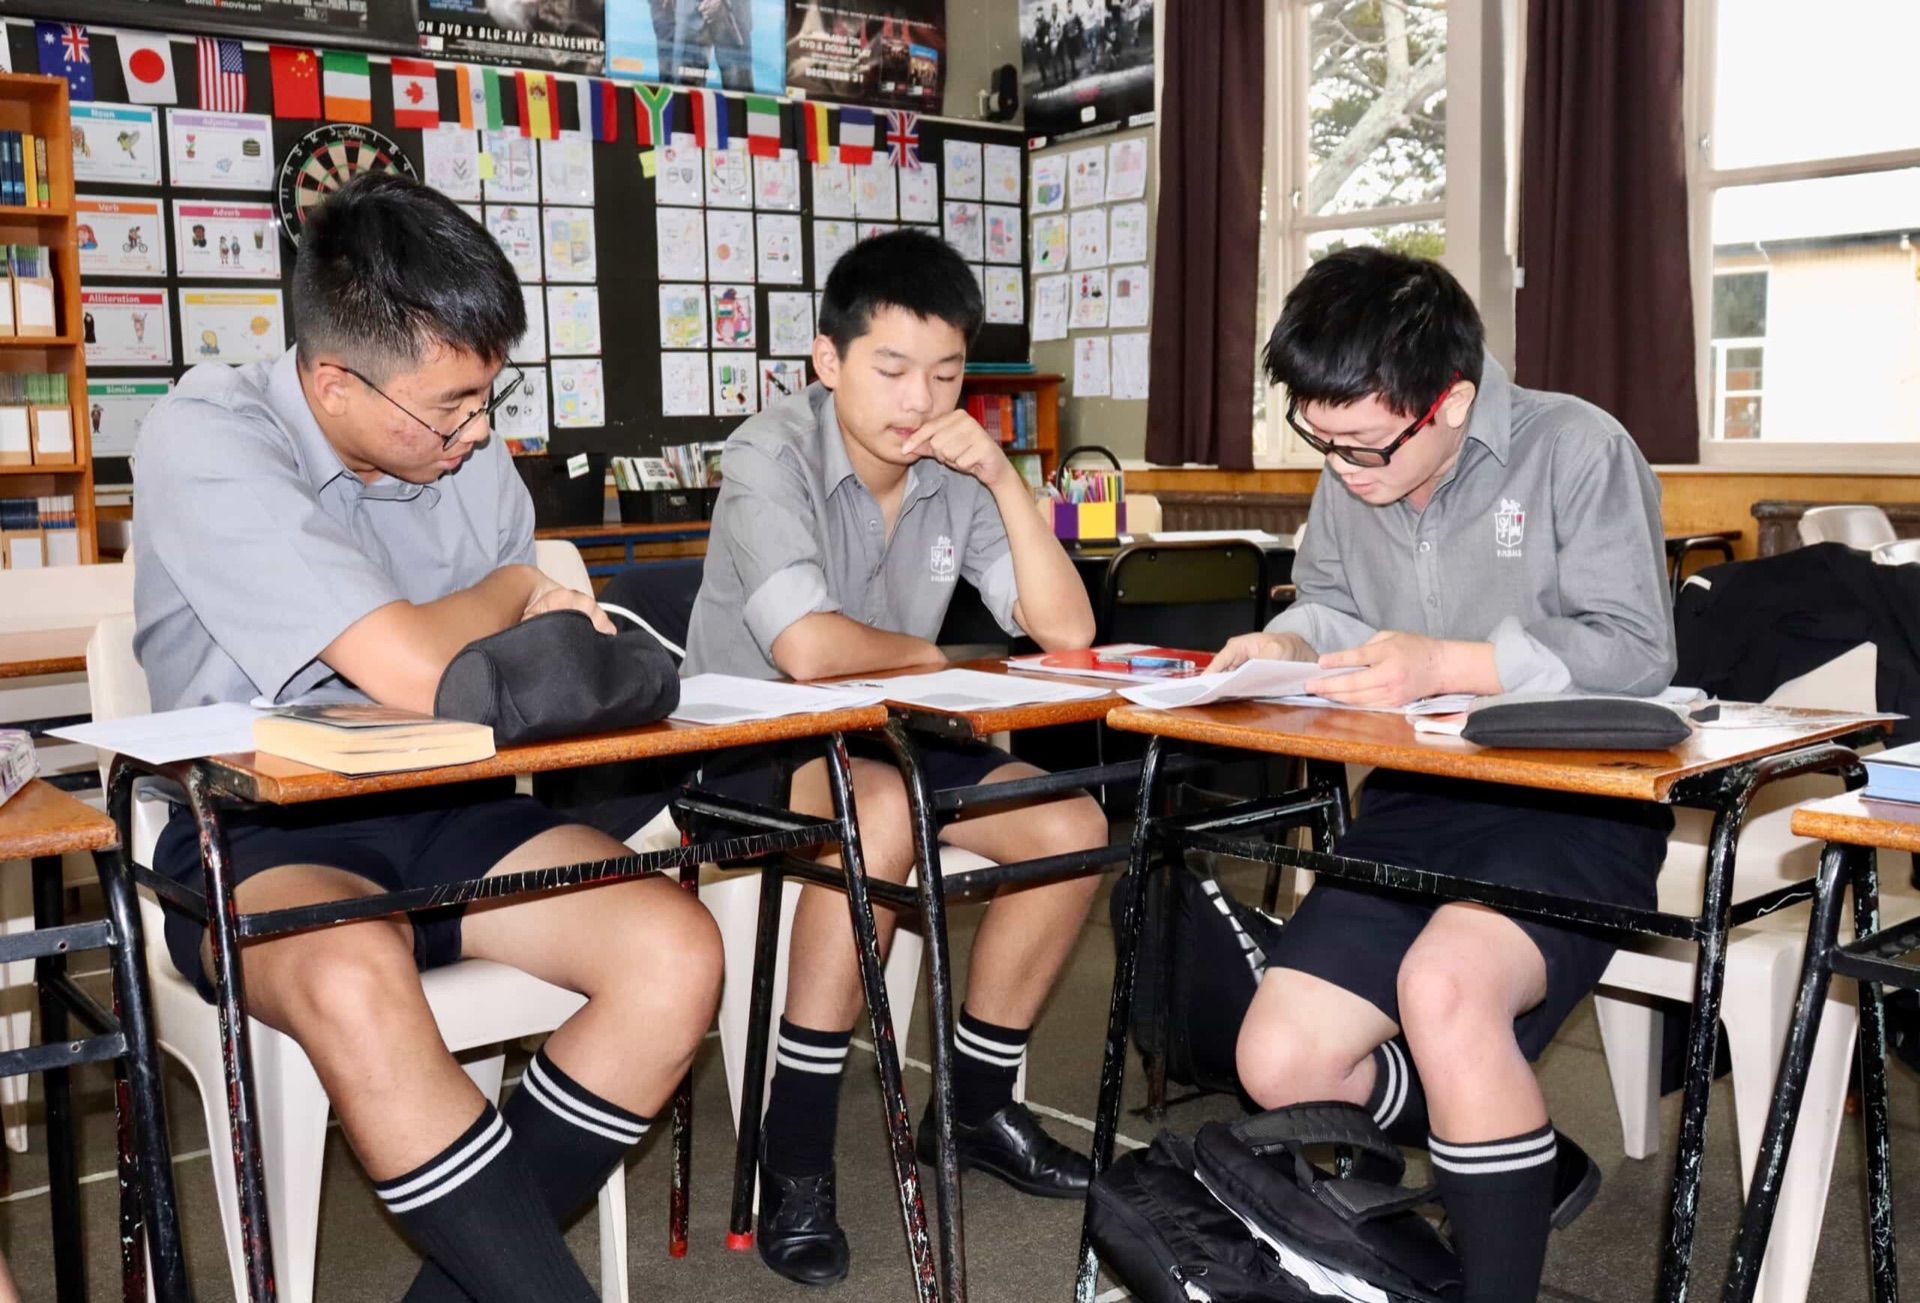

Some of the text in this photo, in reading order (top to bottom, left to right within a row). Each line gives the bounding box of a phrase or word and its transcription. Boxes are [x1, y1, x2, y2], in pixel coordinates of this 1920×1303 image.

[418, 20, 434, 33] ON
[439, 23, 462, 36] DVD
[466, 26, 474, 37] &
[479, 27, 528, 44] BLU-RAY
[550, 34, 605, 51] NOVEMBER
[799, 39, 815, 48] DVD
[805, 67, 850, 81] DECEMBER
[91, 109, 115, 118] Noun
[98, 203, 119, 212] Verb
[212, 208, 240, 217] Adverb
[88, 294, 140, 303] Alliteration
[106, 385, 136, 394] Similes
